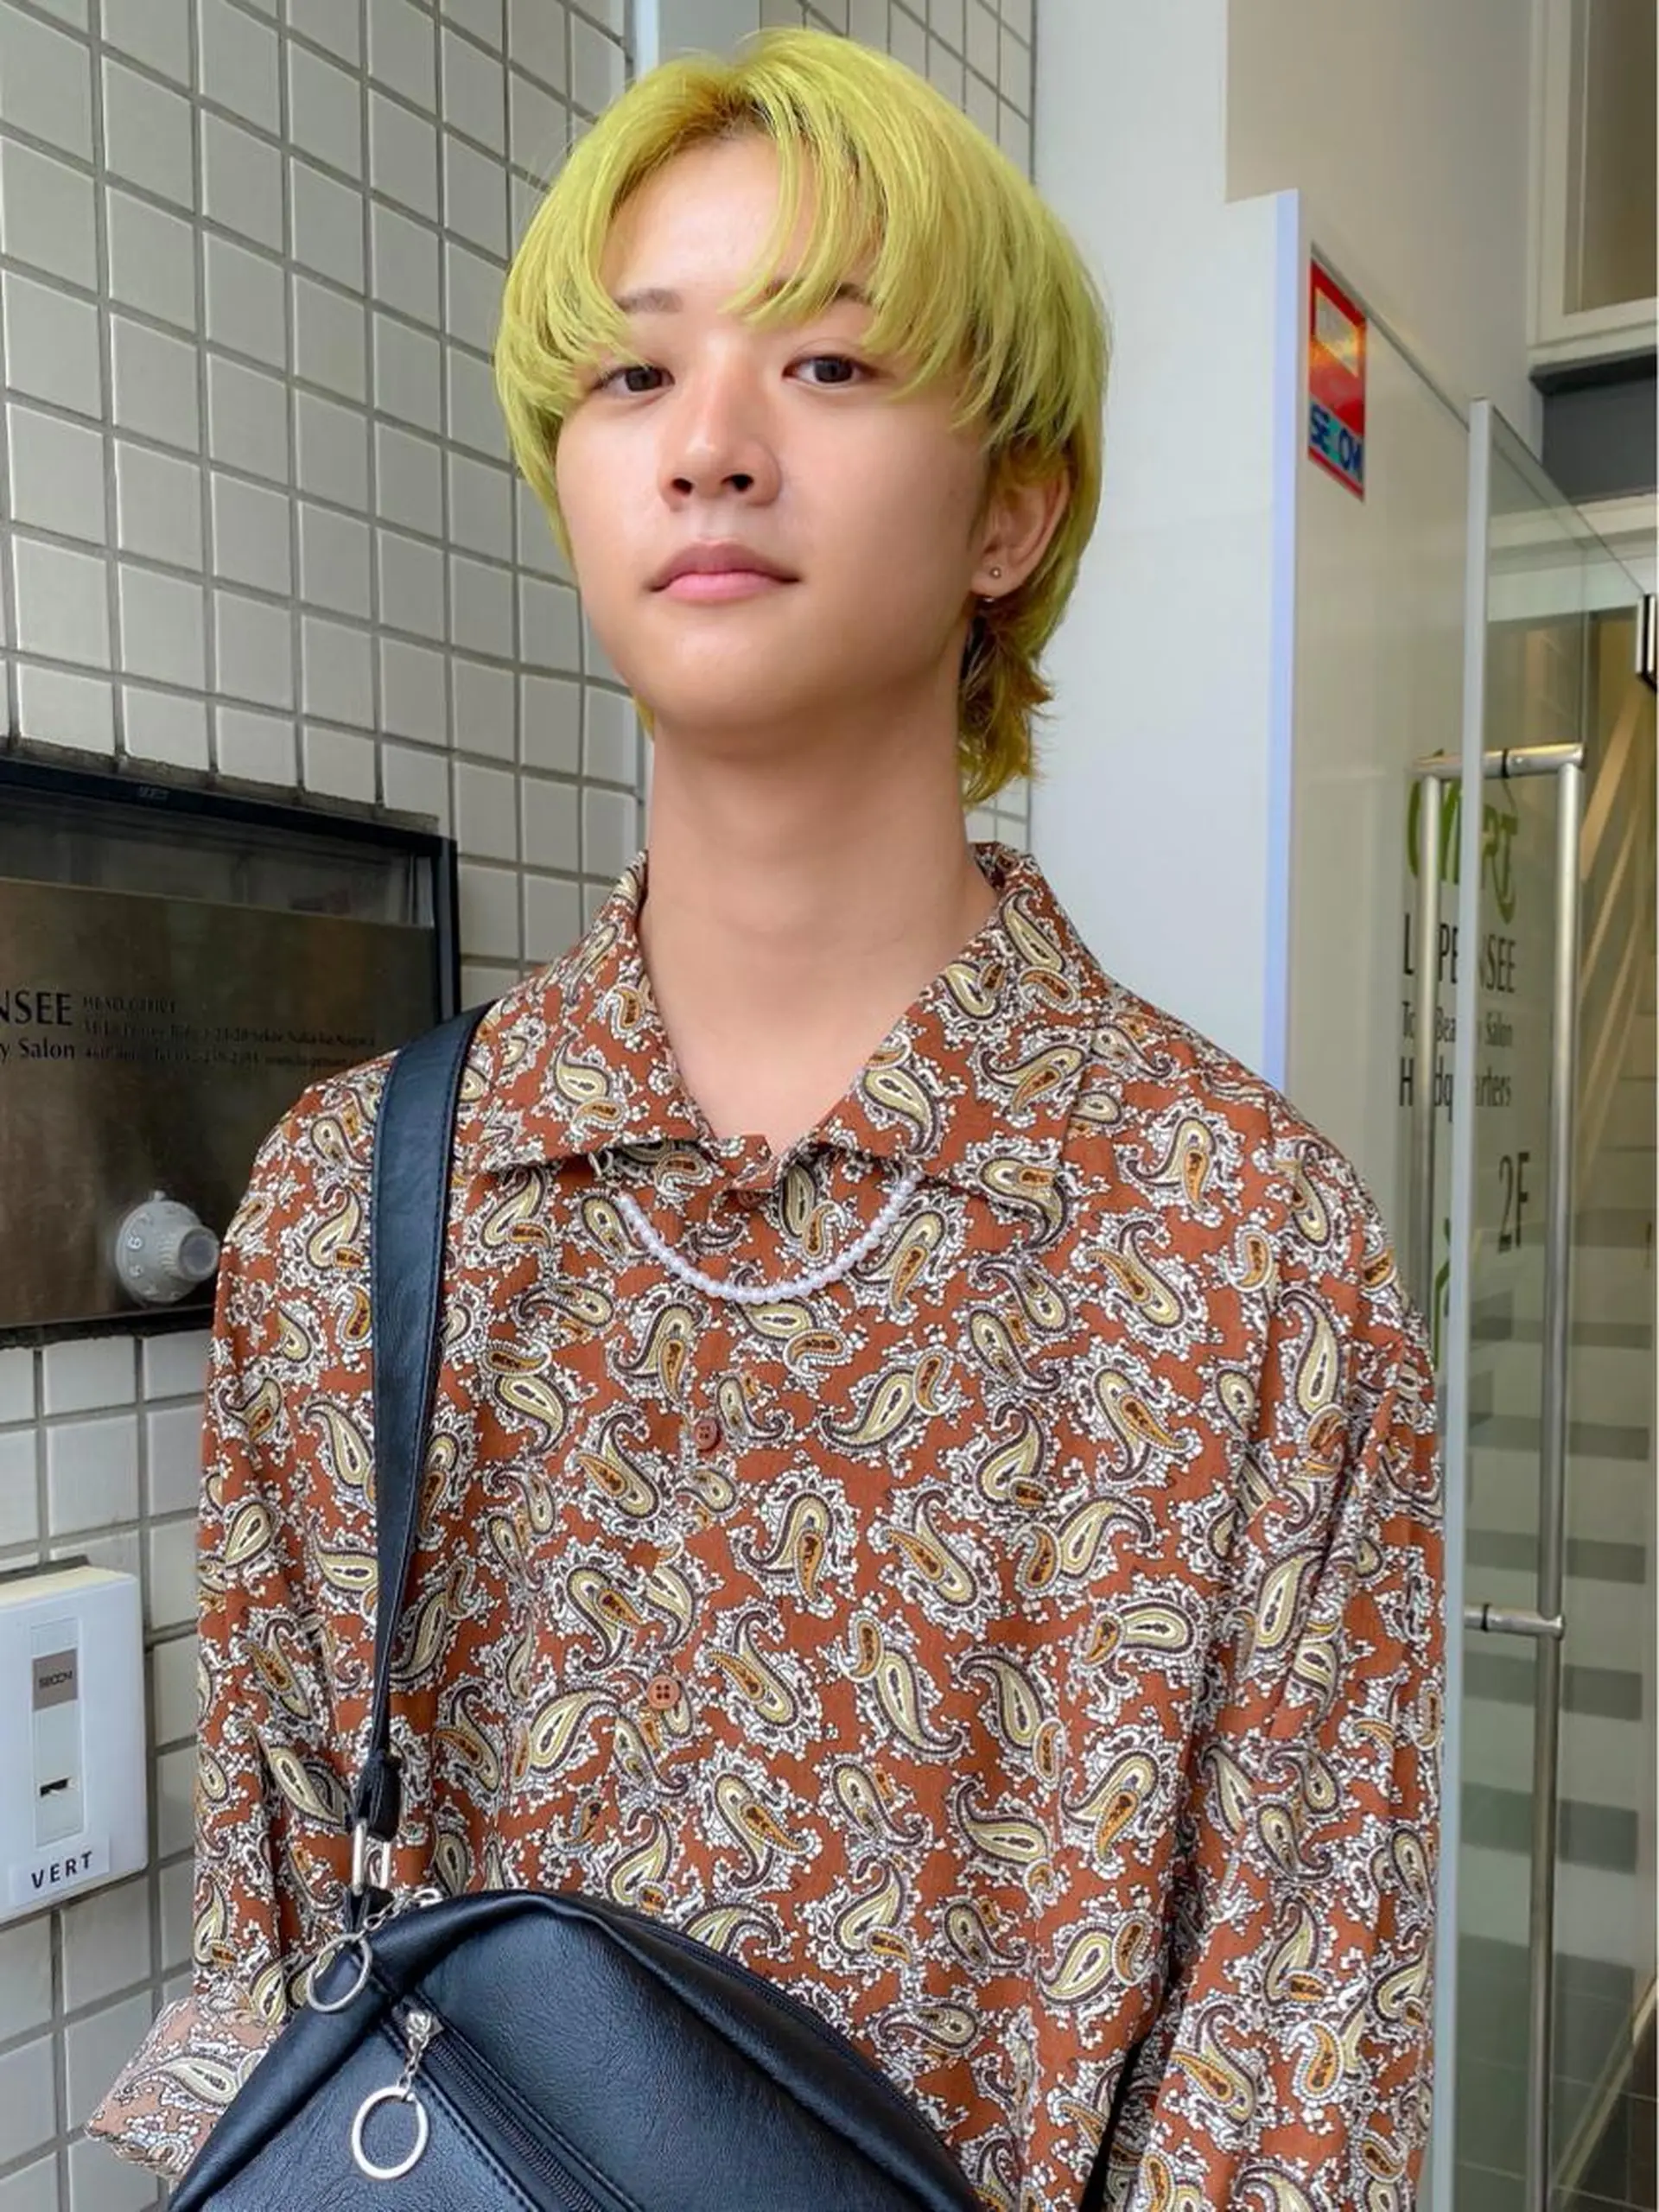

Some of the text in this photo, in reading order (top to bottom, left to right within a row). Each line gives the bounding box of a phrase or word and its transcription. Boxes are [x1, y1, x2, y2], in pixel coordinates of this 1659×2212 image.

[18, 1037, 75, 1060] Salon
[1498, 1152, 1530, 1252] 2F
[31, 1850, 92, 1889] VERT
